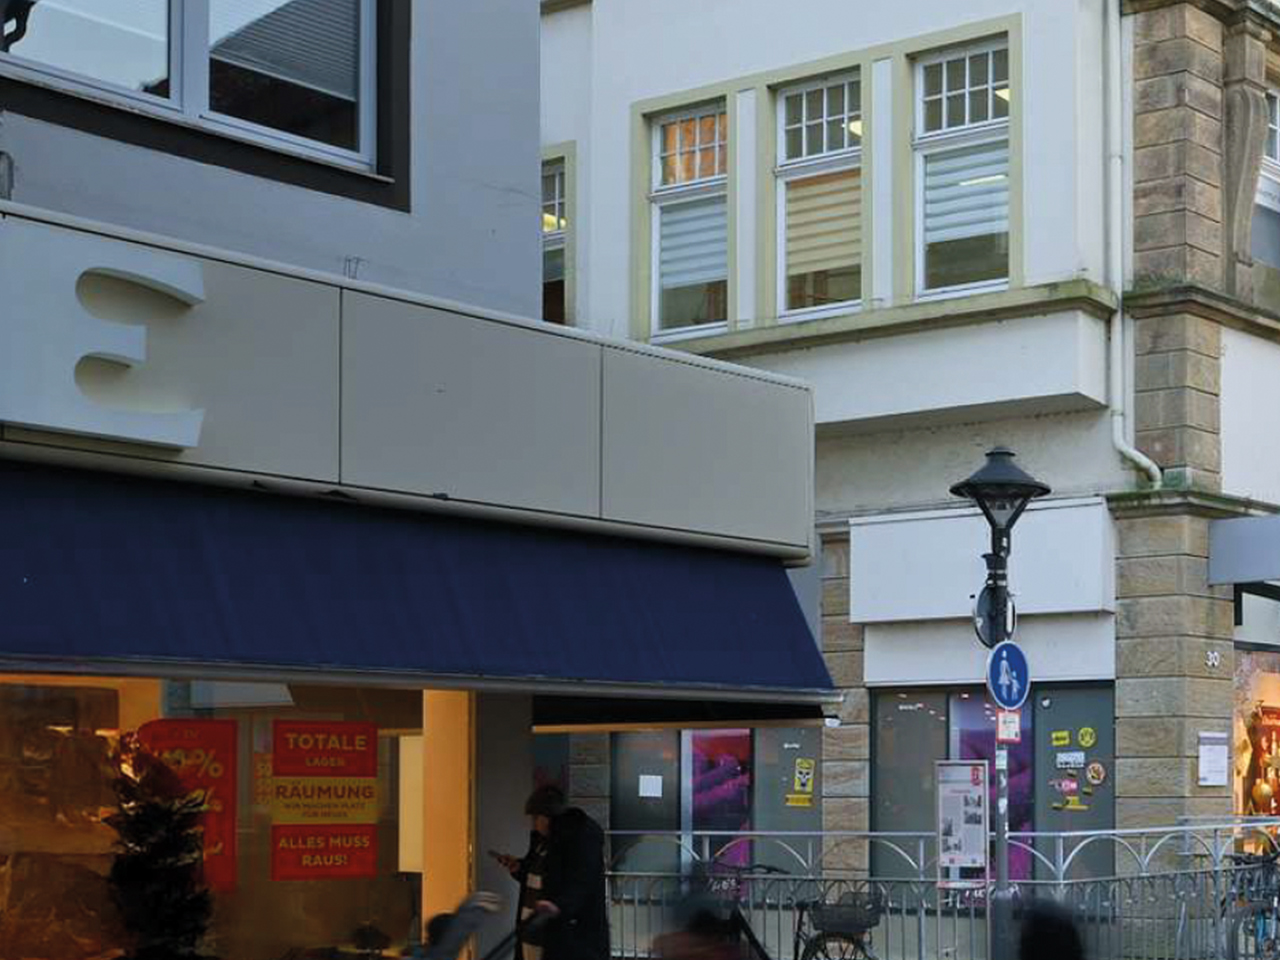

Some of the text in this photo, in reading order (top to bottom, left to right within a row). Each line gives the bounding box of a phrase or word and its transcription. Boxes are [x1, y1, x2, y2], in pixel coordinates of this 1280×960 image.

[1205, 651, 1220, 667] 30
[284, 733, 368, 750] TOTALE
[279, 835, 370, 849] ALLES MUSS
[302, 855, 347, 866] RAUS!
